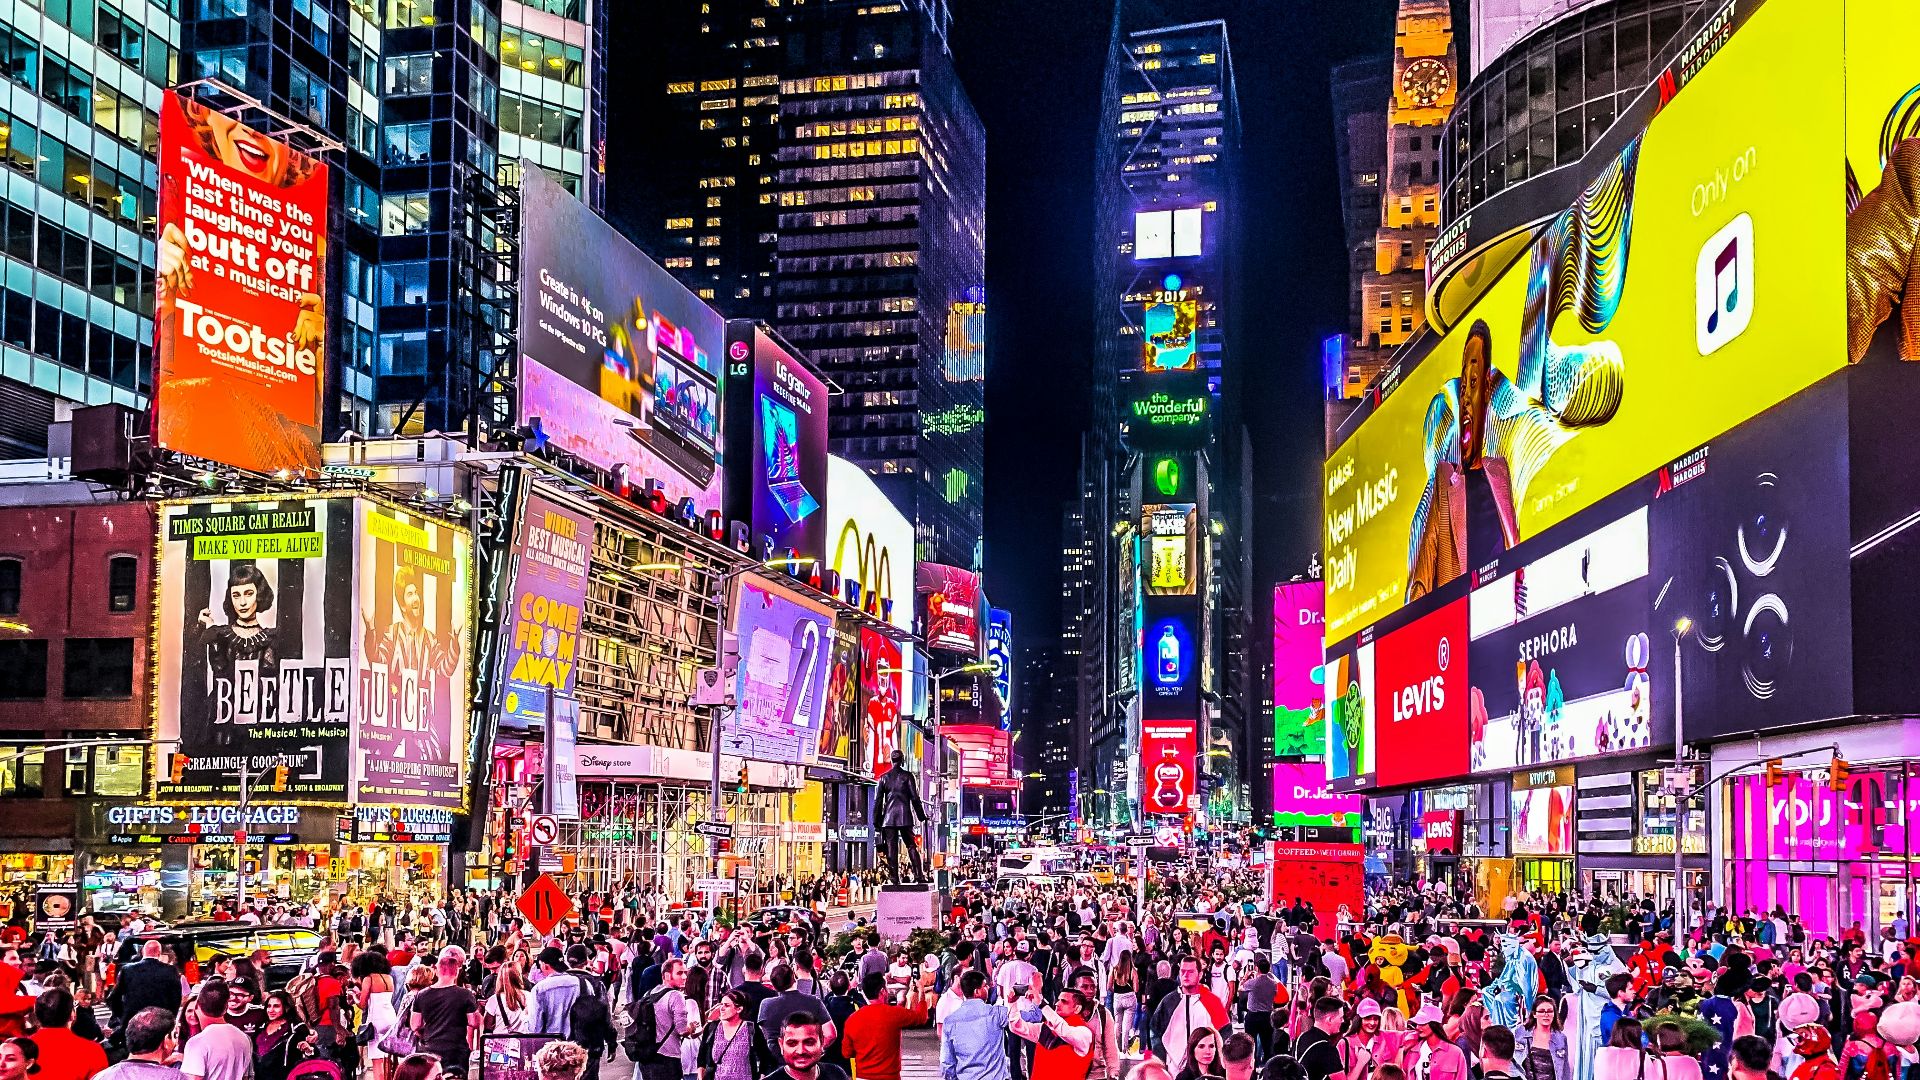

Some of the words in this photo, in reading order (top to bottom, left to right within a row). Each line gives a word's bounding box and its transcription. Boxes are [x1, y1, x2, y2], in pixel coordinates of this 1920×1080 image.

[1681, 0, 1737, 66] MARRIOTT
[1681, 28, 1730, 86] MARQUIS
[1692, 169, 1728, 216] Only
[1733, 146, 1756, 181] on
[186, 176, 223, 208] last
[230, 195, 274, 227] time
[279, 218, 313, 244] you
[248, 188, 281, 213] was
[285, 202, 313, 226] the
[185, 197, 267, 245] laughed
[270, 234, 312, 262] your
[184, 217, 259, 272] butt
[265, 257, 312, 290] off
[191, 254, 209, 272] at
[214, 263, 224, 277] a
[540, 268, 569, 300] Create
[570, 287, 578, 307] in
[581, 297, 591, 316] 4K
[593, 307, 604, 324] on
[1155, 290, 1187, 302] 2019
[540, 290, 580, 330] Windows
[581, 319, 591, 336] 10
[592, 326, 607, 347] PCs
[176, 298, 315, 375] Tootsie
[197, 343, 297, 382] TootsieMusical.com
[730, 363, 748, 376] LG
[776, 360, 787, 382] LG
[1135, 398, 1204, 415] Wonderful
[1151, 393, 1168, 403] the
[1334, 456, 1354, 490] Music
[1674, 446, 1708, 472] MARRIOTT
[1674, 462, 1705, 485] MARQUIS
[1328, 507, 1354, 551] New
[1357, 463, 1398, 528] Music
[173, 517, 203, 535] TIMES
[205, 514, 245, 533] SQUARE
[248, 513, 269, 530] CAN
[272, 511, 311, 528] REALLY
[545, 510, 578, 540] WINNER!
[198, 539, 228, 555] MAKE
[232, 538, 252, 554] YOU
[256, 537, 282, 553] FEEL
[286, 537, 320, 552] ALIVE!
[528, 525, 550, 552] BEST
[551, 533, 585, 565] MUSICAL
[403, 547, 414, 563] ON
[414, 549, 451, 575] BROADWAY!
[1328, 545, 1357, 596] Daily
[520, 592, 579, 633] COME
[515, 621, 576, 663] FROM
[1518, 622, 1577, 663] SEPHORA
[510, 652, 572, 690] AWAY
[214, 667, 345, 724] BEETLE
[249, 728, 262, 738] The
[265, 728, 298, 738] Musical.
[301, 728, 315, 737] The
[318, 727, 348, 737] Musical
[185, 756, 248, 770] CREAMINGLY
[252, 756, 277, 768] GOOD
[282, 755, 308, 767] FUN!"
[375, 760, 421, 775] JAW-DROPPING
[579, 755, 611, 770] Disney
[109, 807, 173, 824] GIFTS
[190, 806, 298, 824] LUGGAGE
[354, 807, 391, 823] GIFTS
[400, 808, 453, 824] LUGGAGE
[1376, 807, 1391, 830] BIG
[1772, 799, 1831, 827] YOU
[117, 836, 132, 844] Apple
[168, 835, 197, 843] Canon
[246, 835, 265, 843] OWER
[199, 824, 219, 833] NY
[798, 825, 810, 833] POLO
[1278, 847, 1315, 856] COFFEED
